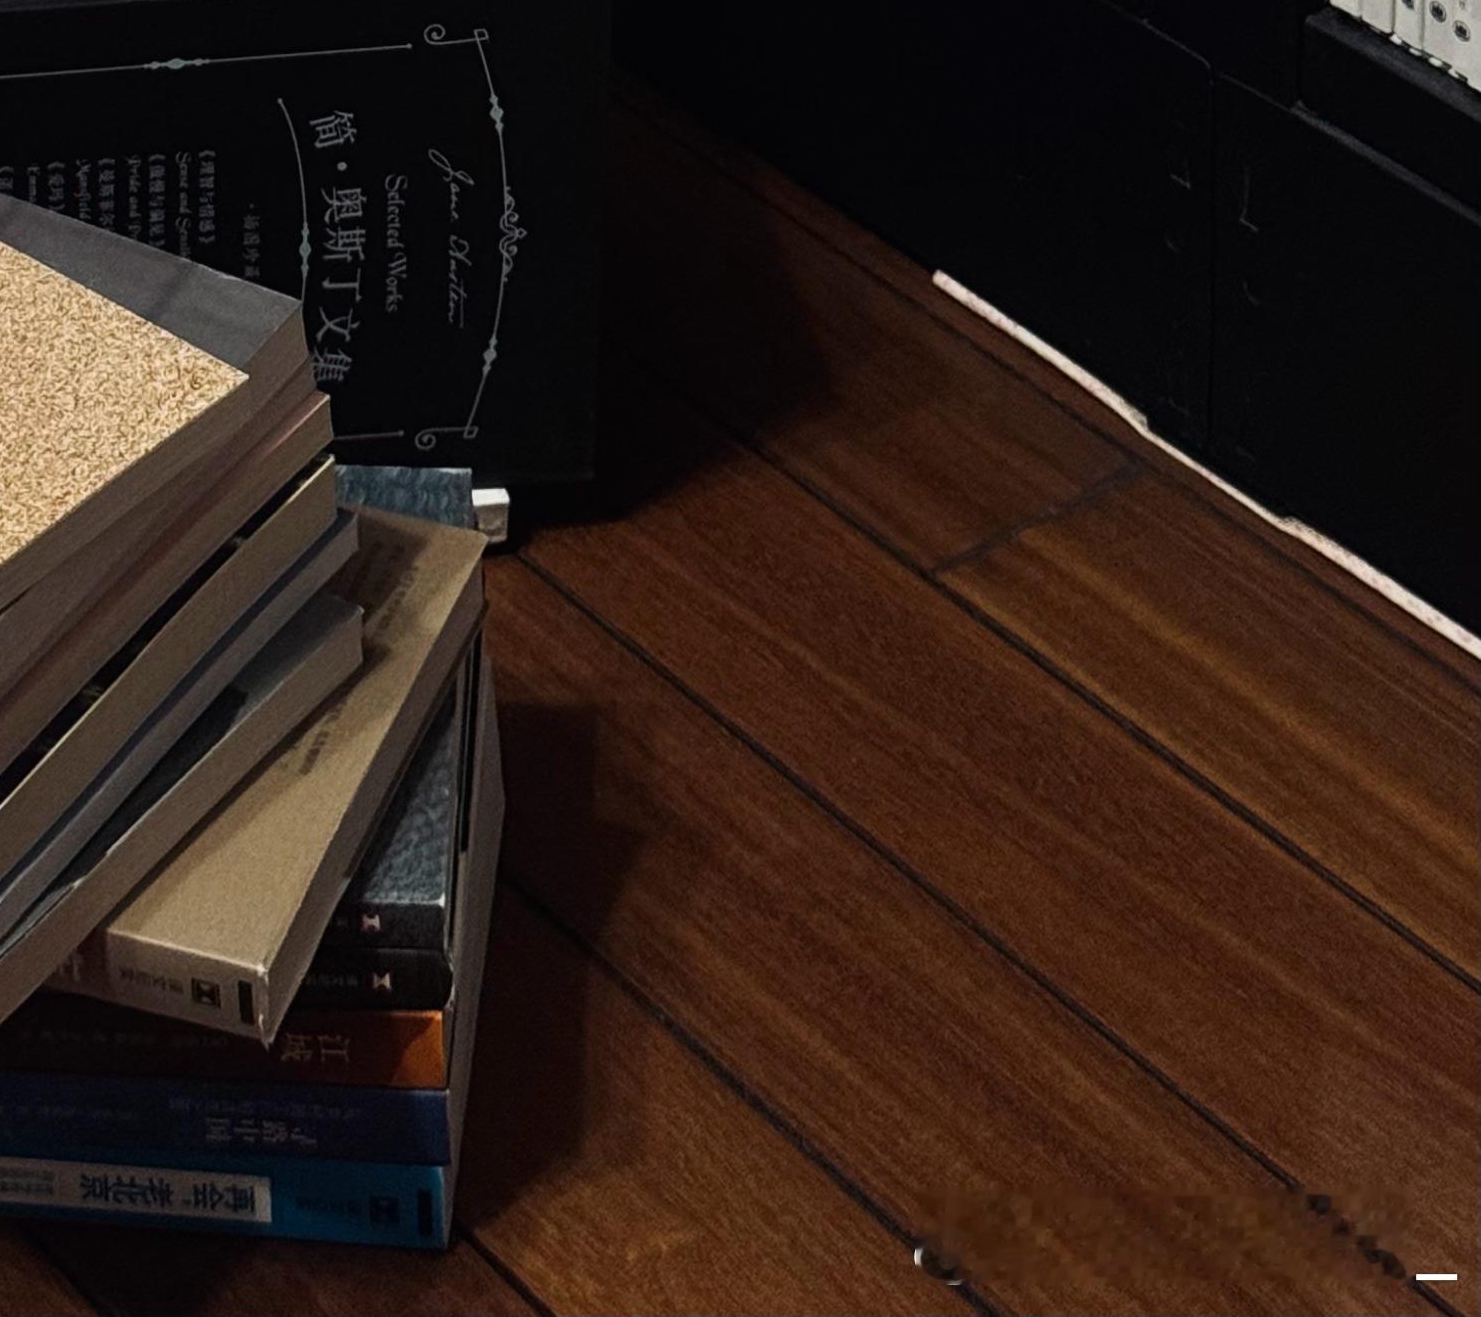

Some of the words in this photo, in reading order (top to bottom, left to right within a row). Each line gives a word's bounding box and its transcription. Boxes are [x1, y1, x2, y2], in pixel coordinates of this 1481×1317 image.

[384, 174, 409, 252] Selected
[309, 109, 367, 382] 简·奥斯丁文集
[386, 251, 407, 313] Works
[280, 1029, 350, 1067] 江城
[81, 1171, 257, 1215] 再会，老北京
